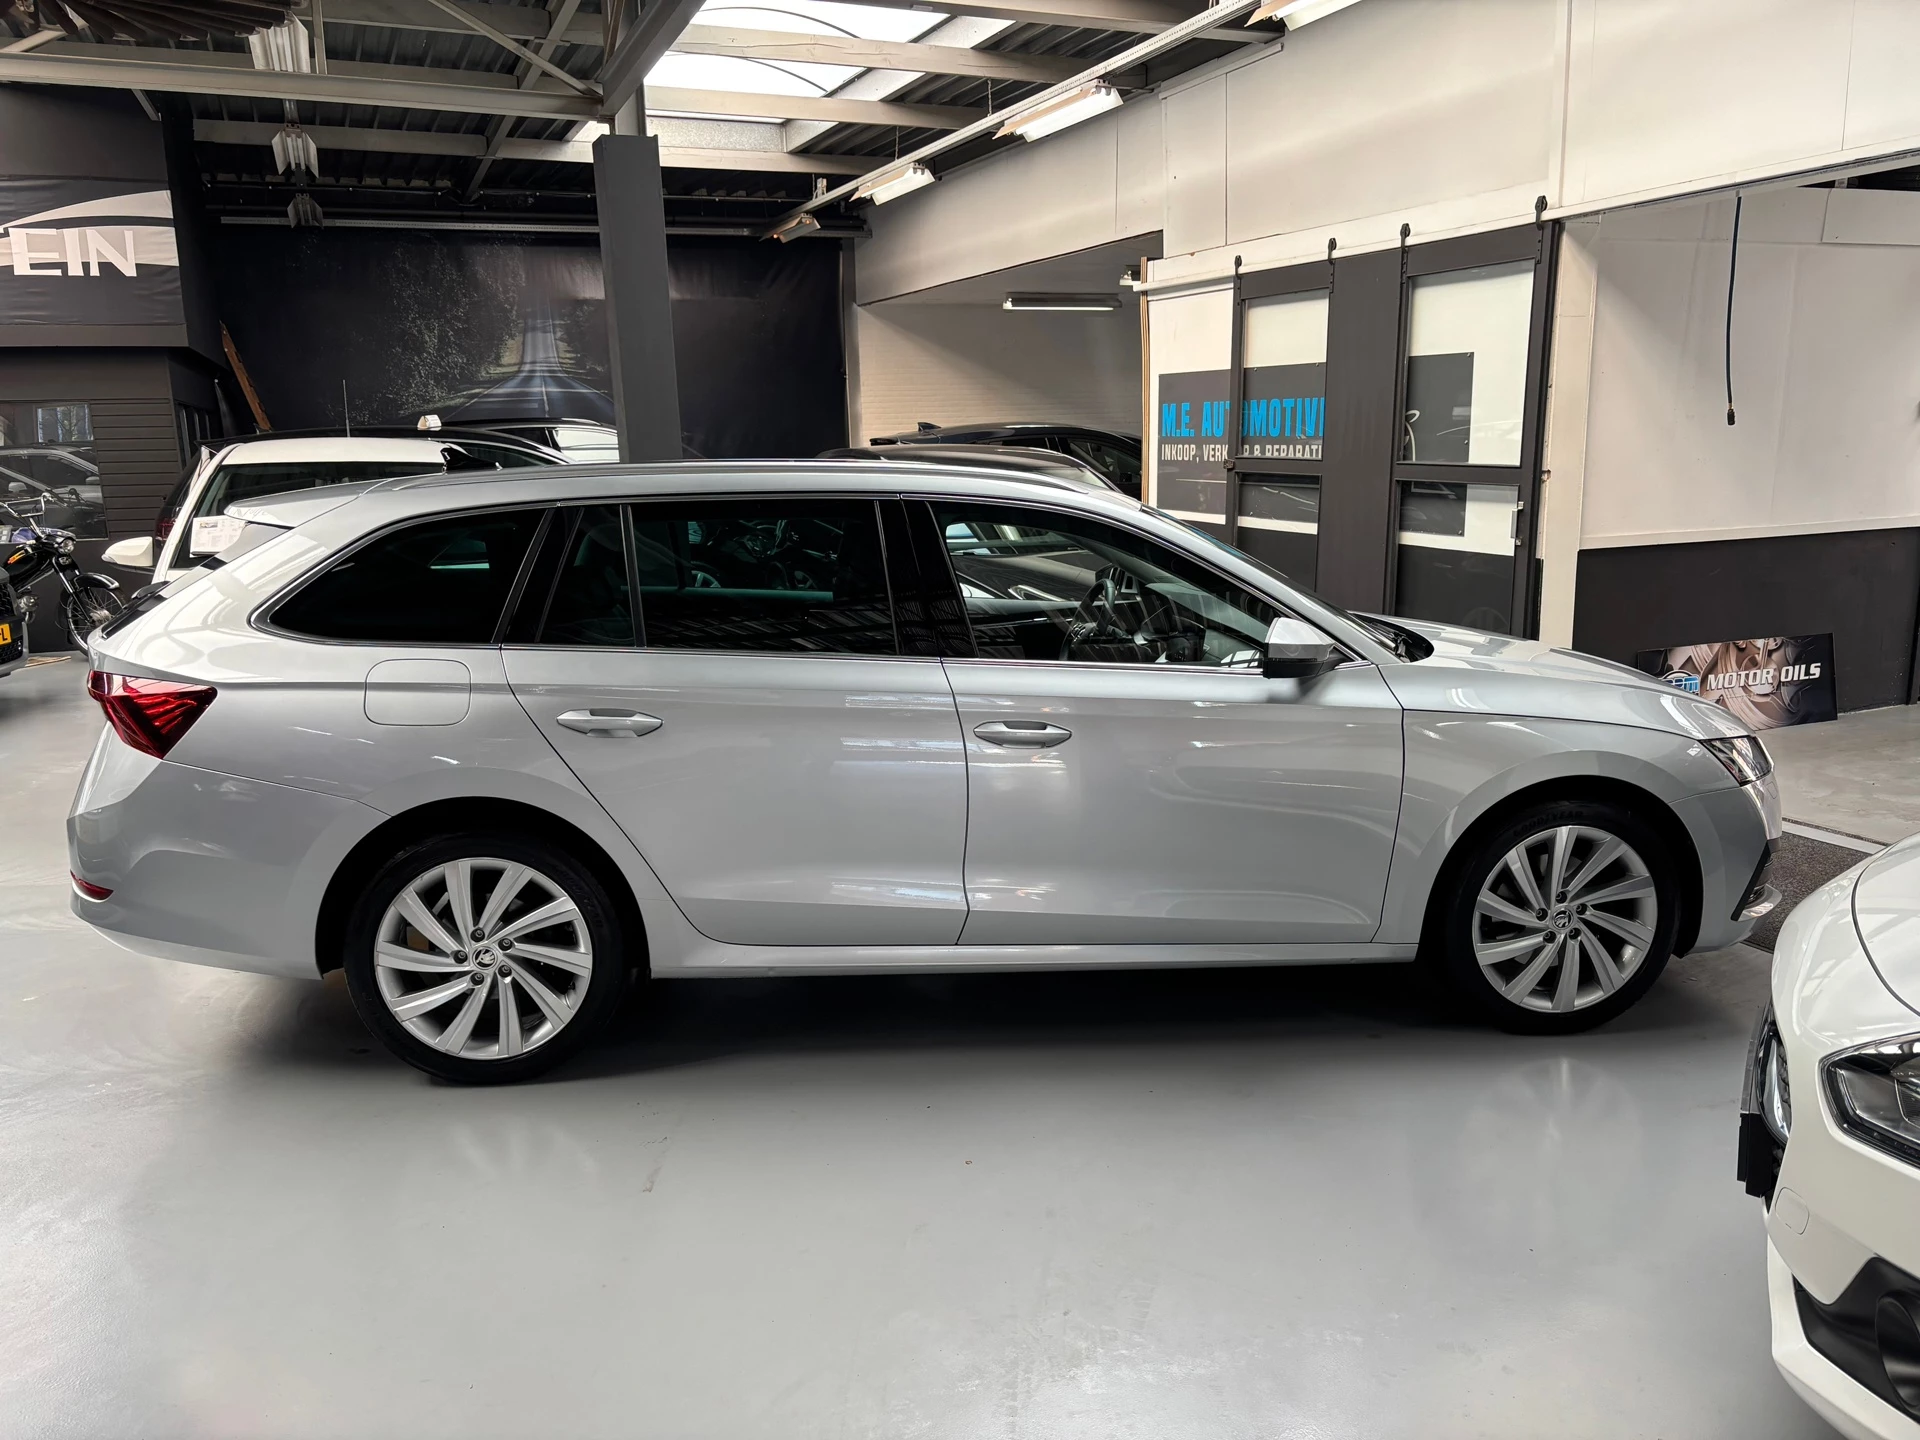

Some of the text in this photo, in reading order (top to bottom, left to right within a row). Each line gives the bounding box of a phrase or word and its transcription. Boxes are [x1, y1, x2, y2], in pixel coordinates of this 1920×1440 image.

[0, 226, 137, 277] EIN
[1162, 403, 1195, 437] M.E.
[1161, 444, 1199, 463] INKOOP,
[1706, 668, 1774, 691] MOTOR
[1780, 663, 1821, 682] OILS
